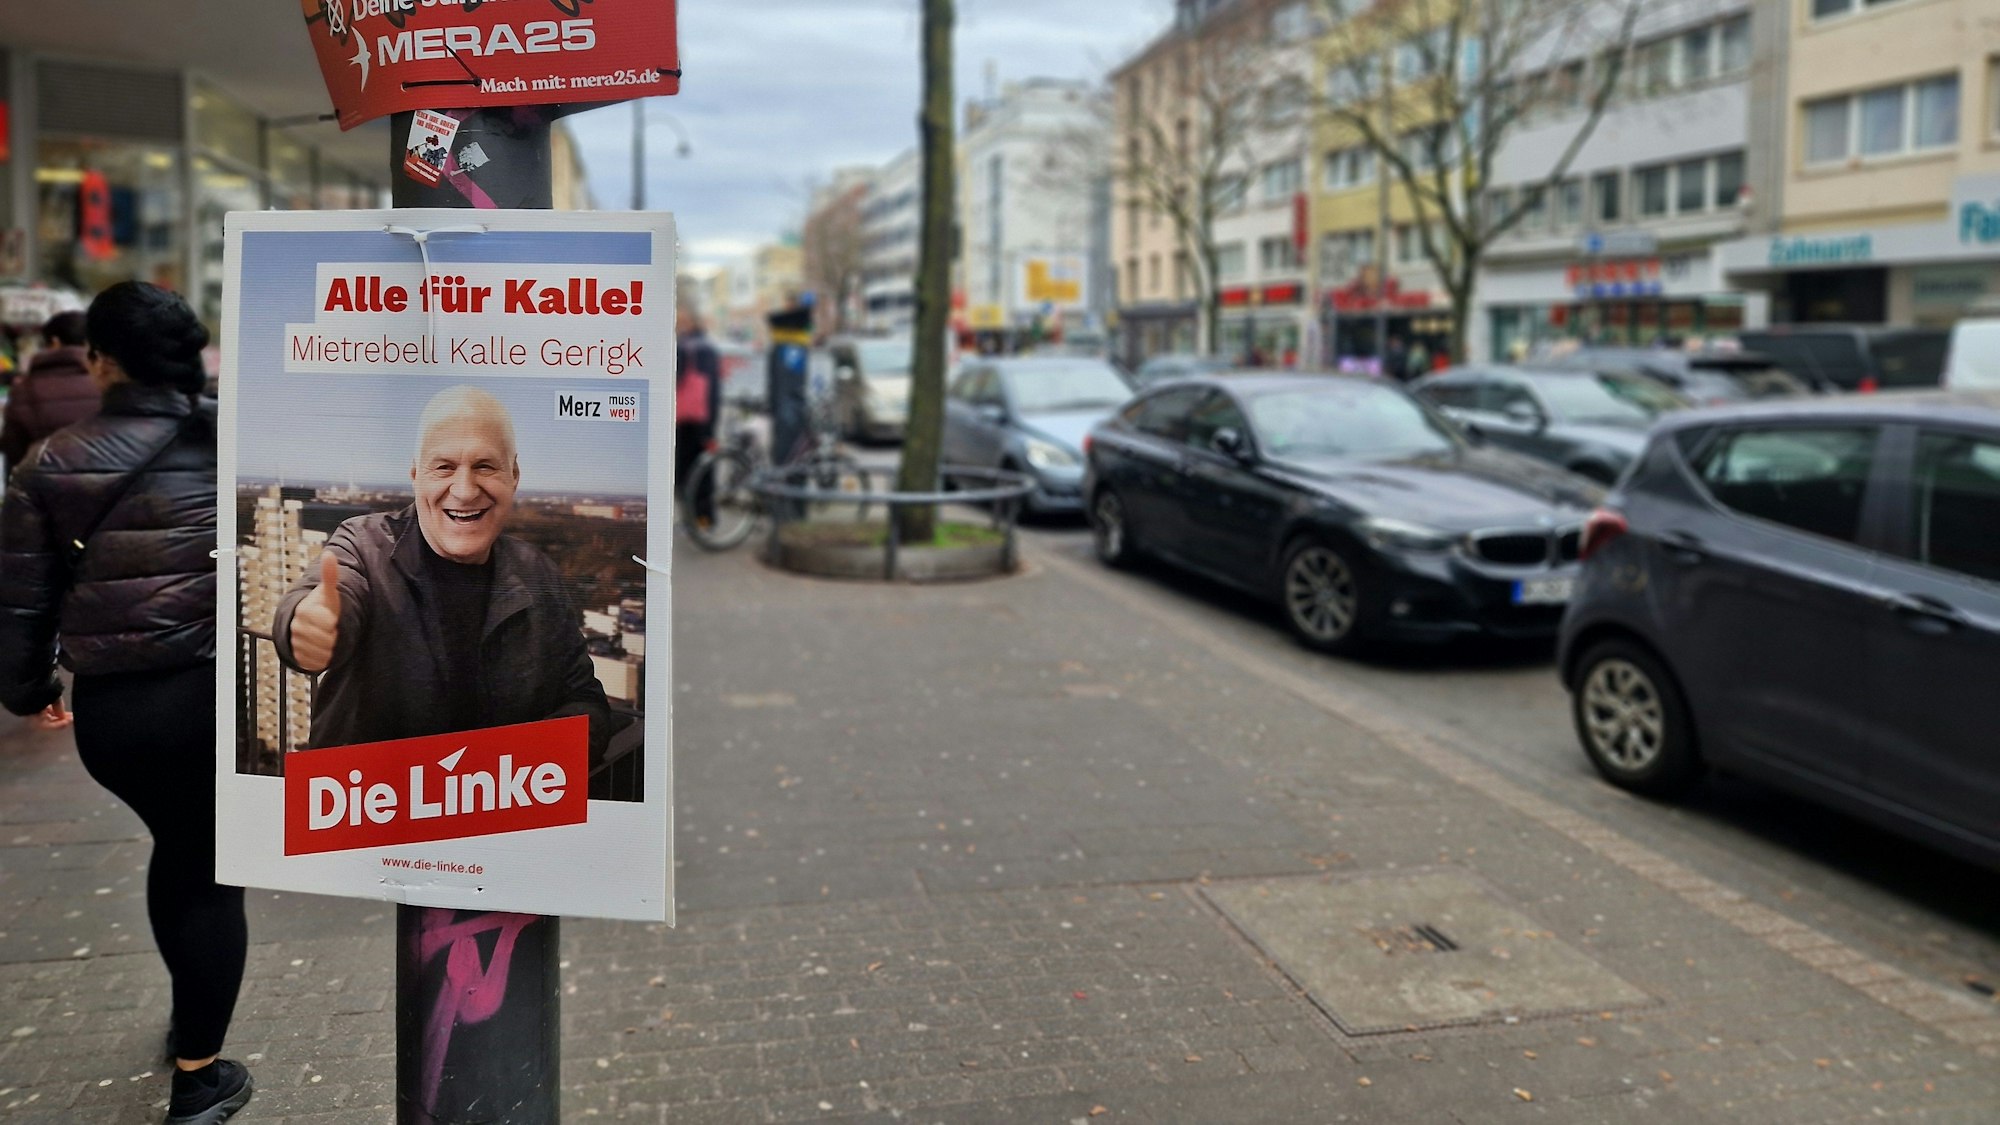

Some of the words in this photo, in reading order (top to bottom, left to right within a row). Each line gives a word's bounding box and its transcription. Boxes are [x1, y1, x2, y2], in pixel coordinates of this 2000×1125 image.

[377, 18, 597, 67] MERA25
[480, 77, 528, 94] Mach
[532, 75, 567, 91] mit:
[570, 69, 661, 89] mera25.de
[323, 275, 408, 313] Alle
[419, 275, 492, 313] für
[504, 277, 644, 316] Kalle!
[292, 334, 439, 365] Mietrebell
[450, 336, 527, 366] Kalle
[540, 337, 644, 375] Gerigk
[559, 394, 601, 417] Merz
[609, 395, 636, 406] muss
[609, 408, 635, 421] weg!
[308, 769, 398, 831] Die
[409, 746, 567, 821] Linke
[381, 856, 484, 875] www.die-linke.de
